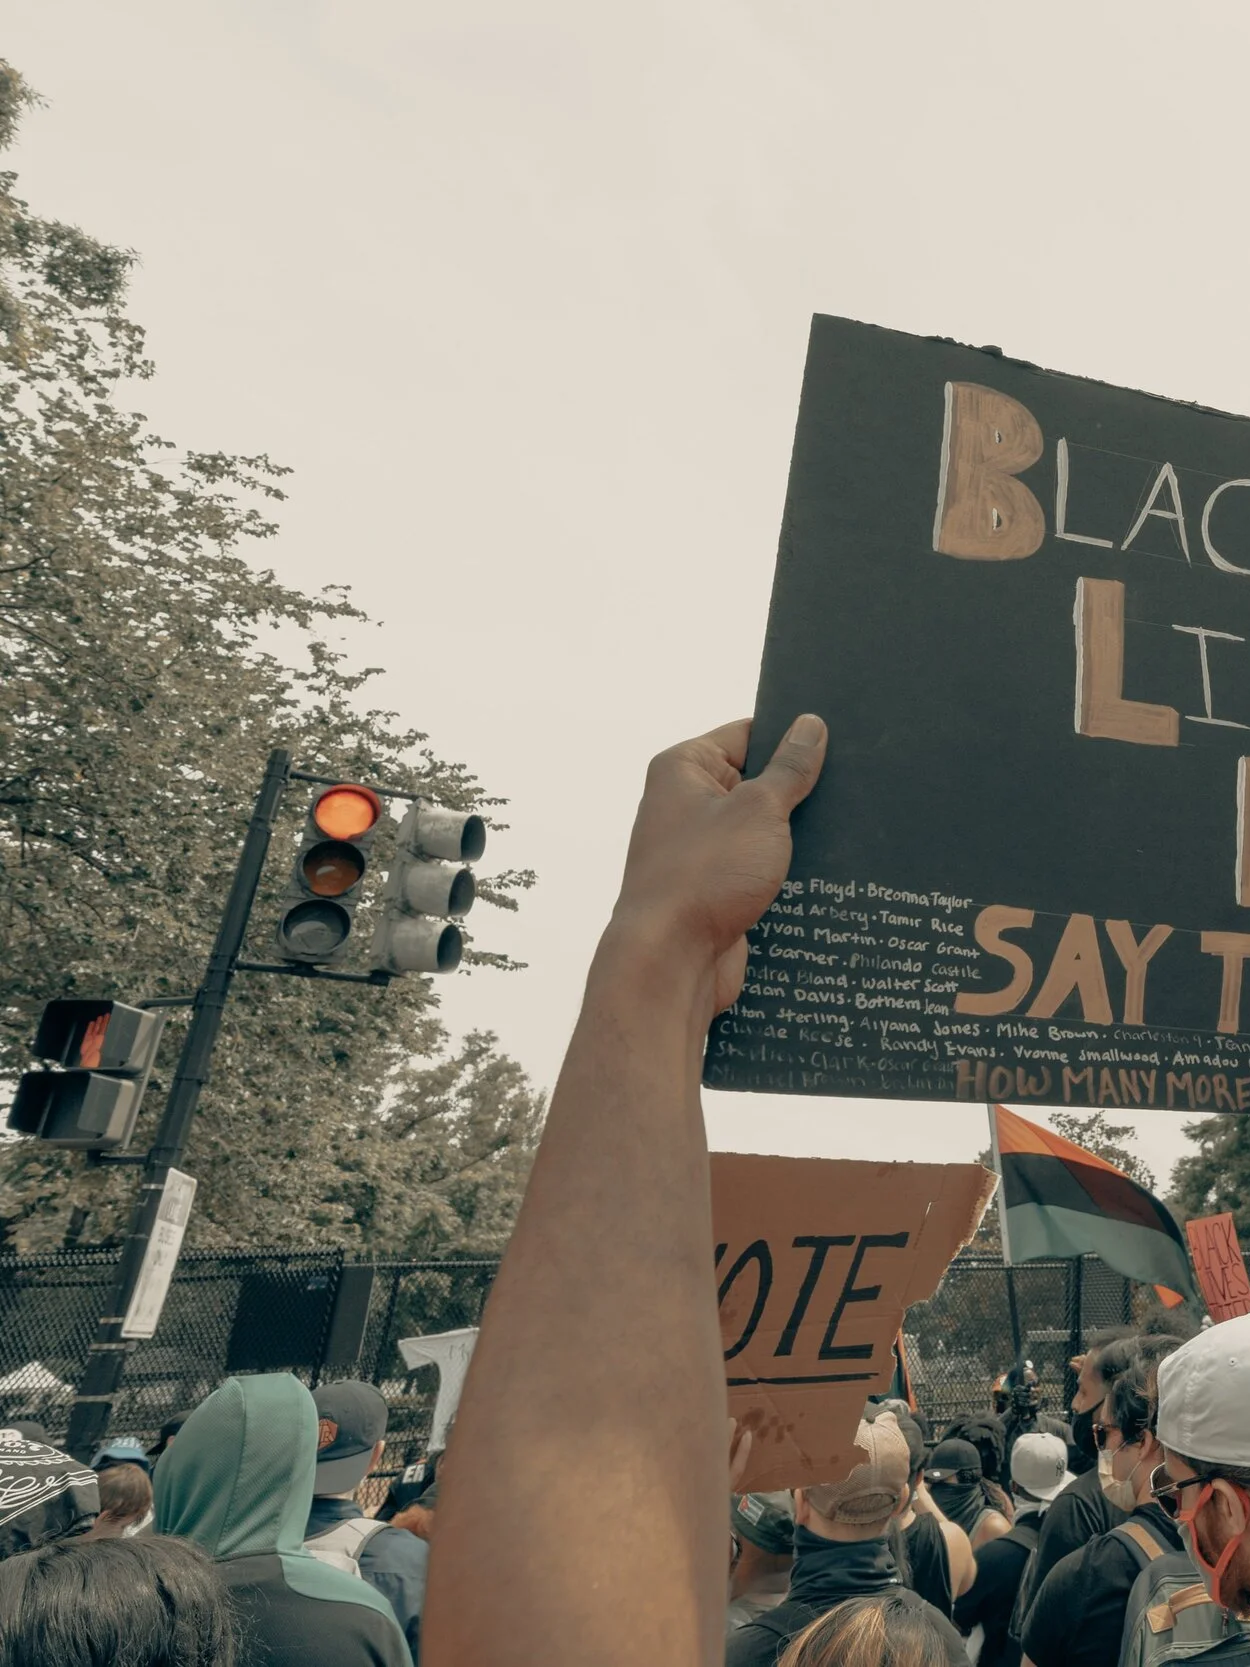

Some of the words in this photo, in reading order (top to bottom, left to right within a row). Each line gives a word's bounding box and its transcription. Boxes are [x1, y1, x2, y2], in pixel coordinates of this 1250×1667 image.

[809, 878, 856, 903] Floyd
[867, 882, 929, 907] Breonna
[930, 891, 973, 914] Taylor
[769, 902, 804, 916] aud
[809, 903, 869, 931] Arbery
[879, 910, 923, 928] Tamir
[930, 918, 965, 936] Rice
[751, 921, 805, 938] yvon
[813, 927, 877, 946] Martin
[887, 936, 931, 952] Oscar
[936, 941, 981, 959] Grant
[746, 964, 790, 983] ndra
[797, 969, 849, 988] Bland
[923, 978, 960, 993] Scott
[768, 943, 839, 966] Garner
[849, 952, 923, 973] Philando
[931, 962, 983, 979] Castile
[954, 904, 1174, 1026] SAY
[741, 982, 787, 998] rdan
[793, 988, 846, 1005] Davis
[923, 998, 949, 1017] Jean
[776, 1007, 850, 1032] Sterling
[860, 1016, 921, 1036] Aiyana
[933, 1020, 981, 1037] Jones
[997, 1022, 1040, 1039] Mike
[1048, 1025, 1099, 1041] Brown
[1113, 1028, 1190, 1045] Charleston
[880, 1036, 940, 1060] Randy
[943, 1041, 997, 1058] Evans
[1013, 1045, 1069, 1063] Yvonne
[1078, 1048, 1161, 1066] Smallwood
[956, 1058, 1051, 1100] HOW
[1062, 1065, 1157, 1105] MANY
[714, 1231, 910, 1361] OTE
